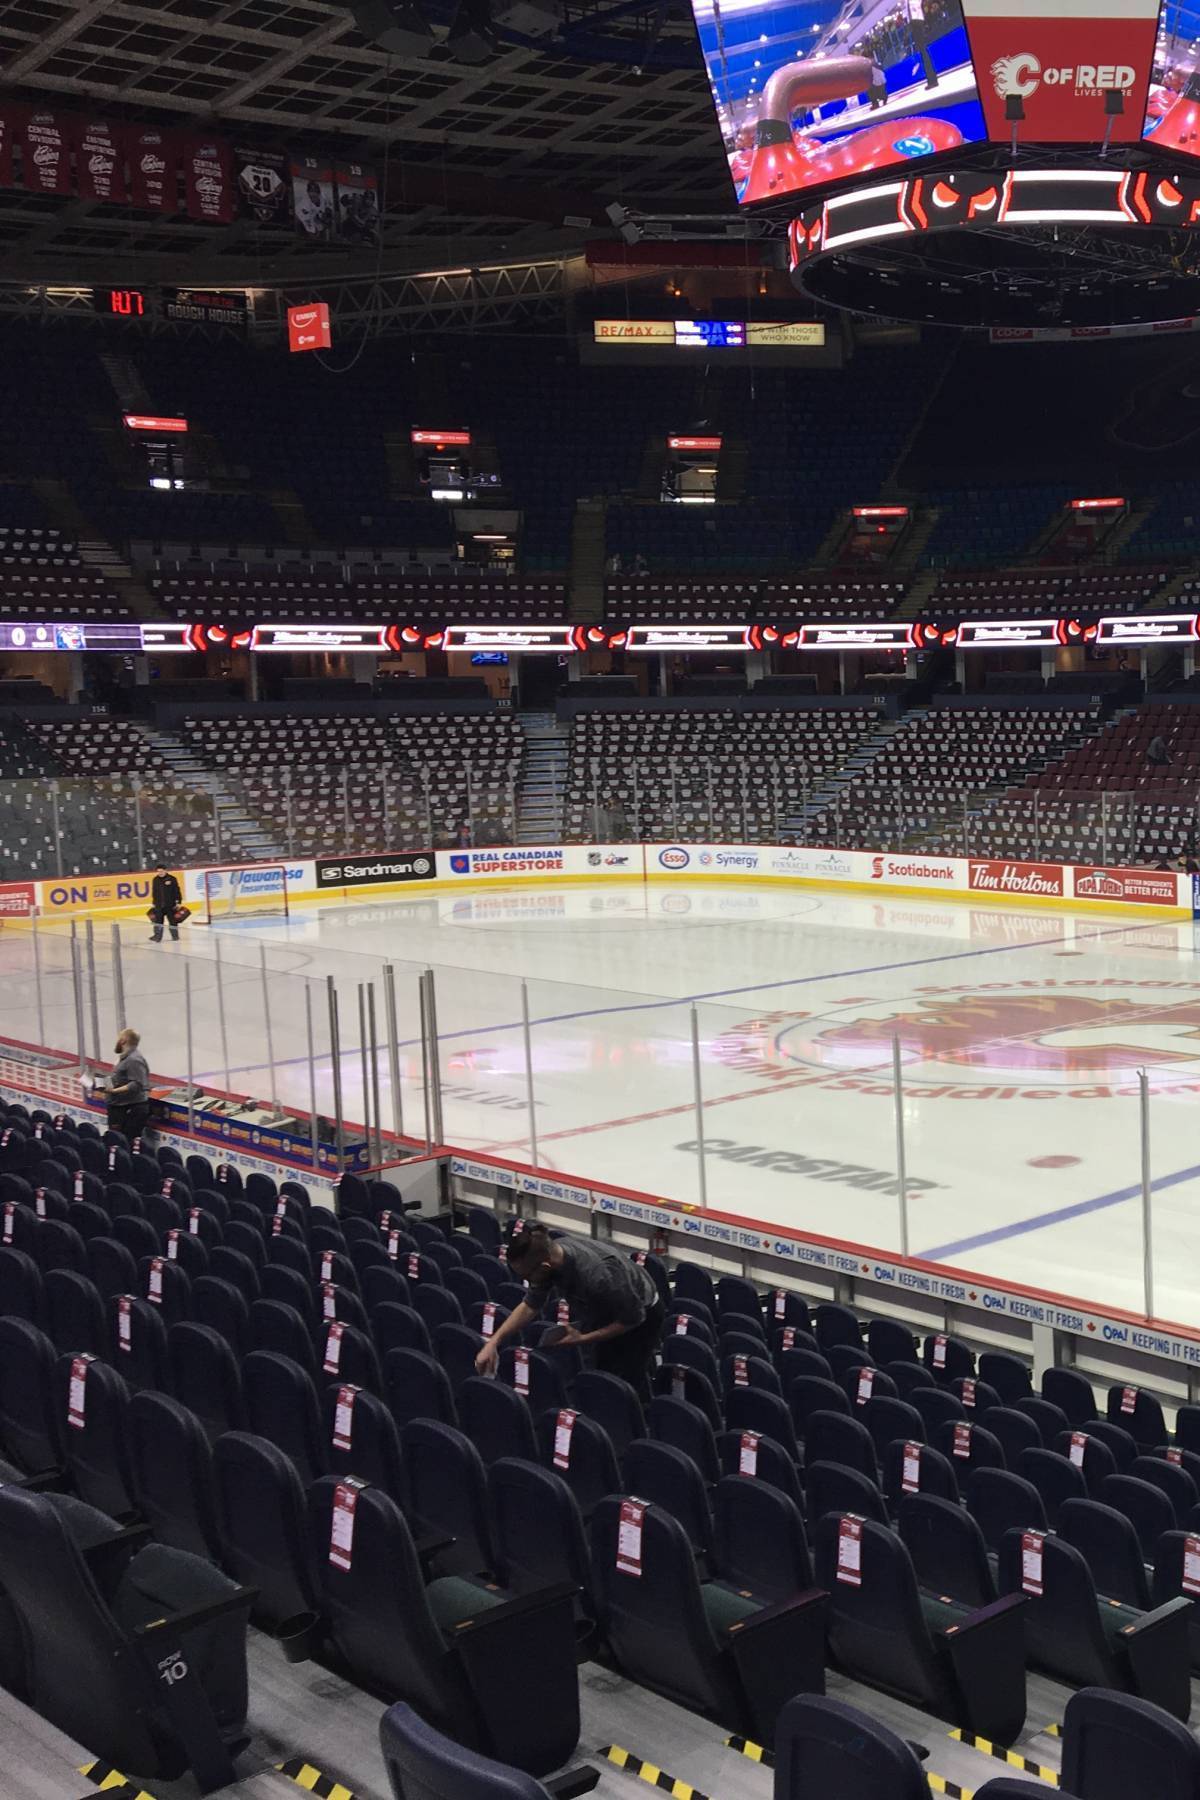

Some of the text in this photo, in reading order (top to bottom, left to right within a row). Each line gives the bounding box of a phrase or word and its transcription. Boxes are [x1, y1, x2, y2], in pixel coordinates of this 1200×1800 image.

[1042, 68, 1073, 85] OF
[1074, 65, 1136, 88] RED
[253, 176, 271, 193] 20
[167, 304, 245, 323] ROUGH HOUSE
[760, 334, 811, 342] WHO KNOW
[791, 326, 819, 335] THOSE
[472, 851, 563, 862] REAL CANADIAN
[663, 853, 686, 863] Esso
[716, 853, 759, 869] Synergy
[343, 863, 412, 878] Sandman
[472, 859, 564, 874] SUPERSTORE
[888, 862, 954, 880] Scotiabank
[970, 864, 1060, 894] Tim Hortons
[50, 886, 88, 906] ON
[93, 887, 111, 899] the
[1124, 885, 1151, 896] BETTER
[674, 1138, 939, 1198] CARSTAR
[683, 1219, 761, 1248] OPA! KEEPING IT FRESH
[774, 1241, 859, 1272] OPA! KEEPING IT FRESH
[874, 1266, 966, 1301] OPA! KEEPING IT FRESH
[982, 1293, 1083, 1332] OPA! KEEPING IT FRESH
[1103, 1325, 1129, 1342] OPA!
[1132, 1331, 1170, 1355] KEEPING
[1173, 1341, 1181, 1356] IT
